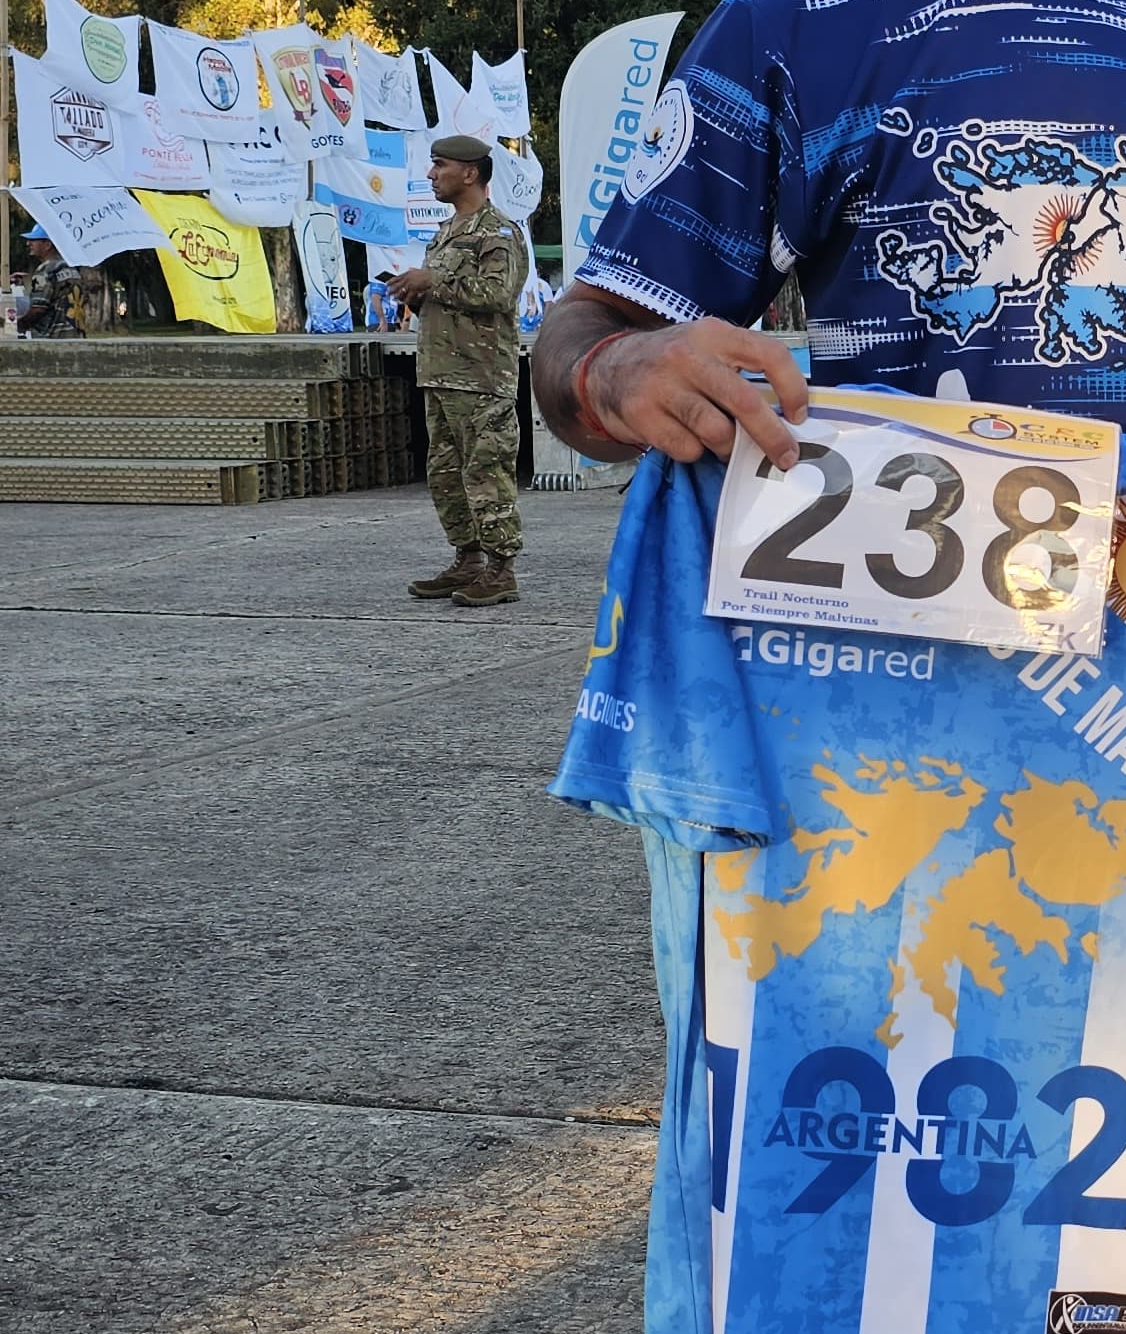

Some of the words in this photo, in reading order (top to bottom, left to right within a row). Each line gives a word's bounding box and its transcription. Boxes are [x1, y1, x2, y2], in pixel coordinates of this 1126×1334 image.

[588, 38, 659, 218] Gigared
[740, 441, 1081, 612] 238
[720, 601, 747, 612] Por
[751, 604, 810, 620] Siempre
[814, 610, 879, 627] Malvinas
[743, 588, 778, 601] Trail
[782, 593, 849, 609] Nocturno
[758, 629, 933, 681] Gigared
[1017, 653, 1101, 716] DE
[763, 1111, 1037, 1160] ARGENTINA
